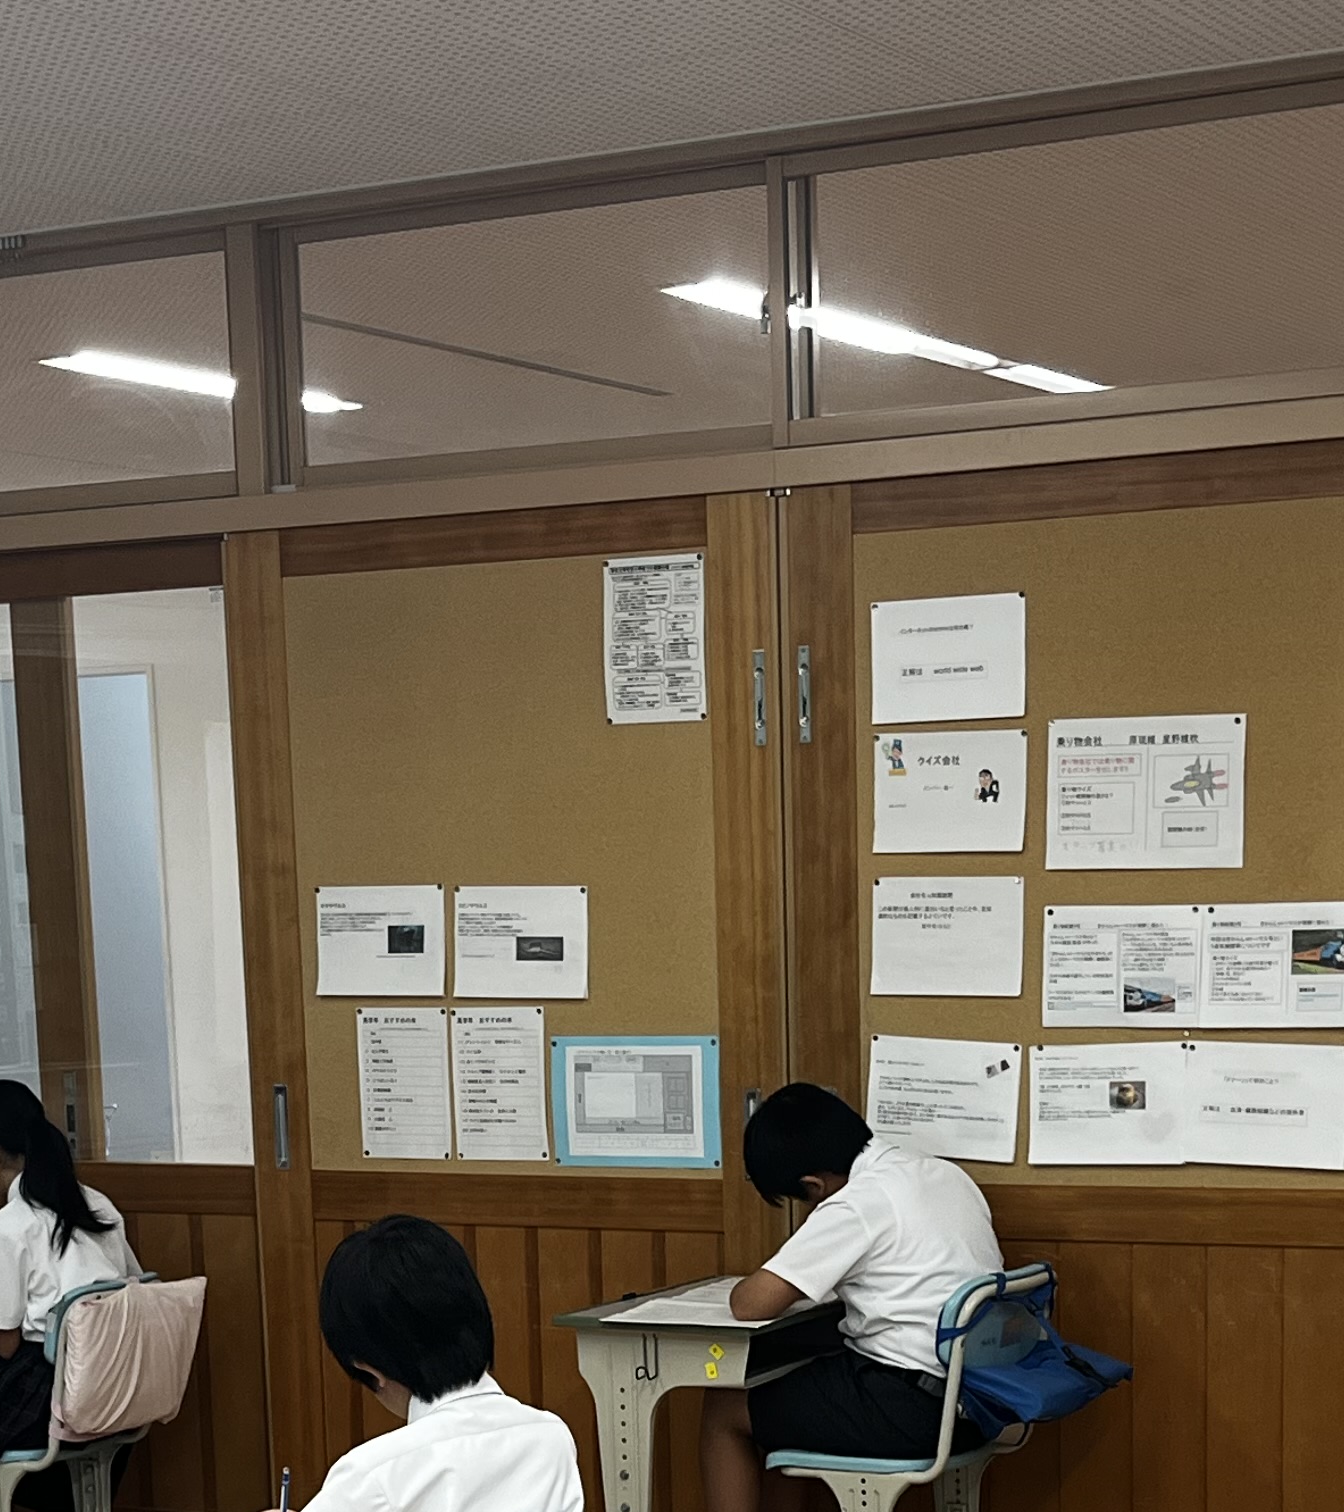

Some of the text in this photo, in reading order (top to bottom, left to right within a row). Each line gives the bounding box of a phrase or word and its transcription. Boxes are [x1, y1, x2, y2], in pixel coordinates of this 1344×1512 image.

[917, 755, 960, 767] クイズ会社
